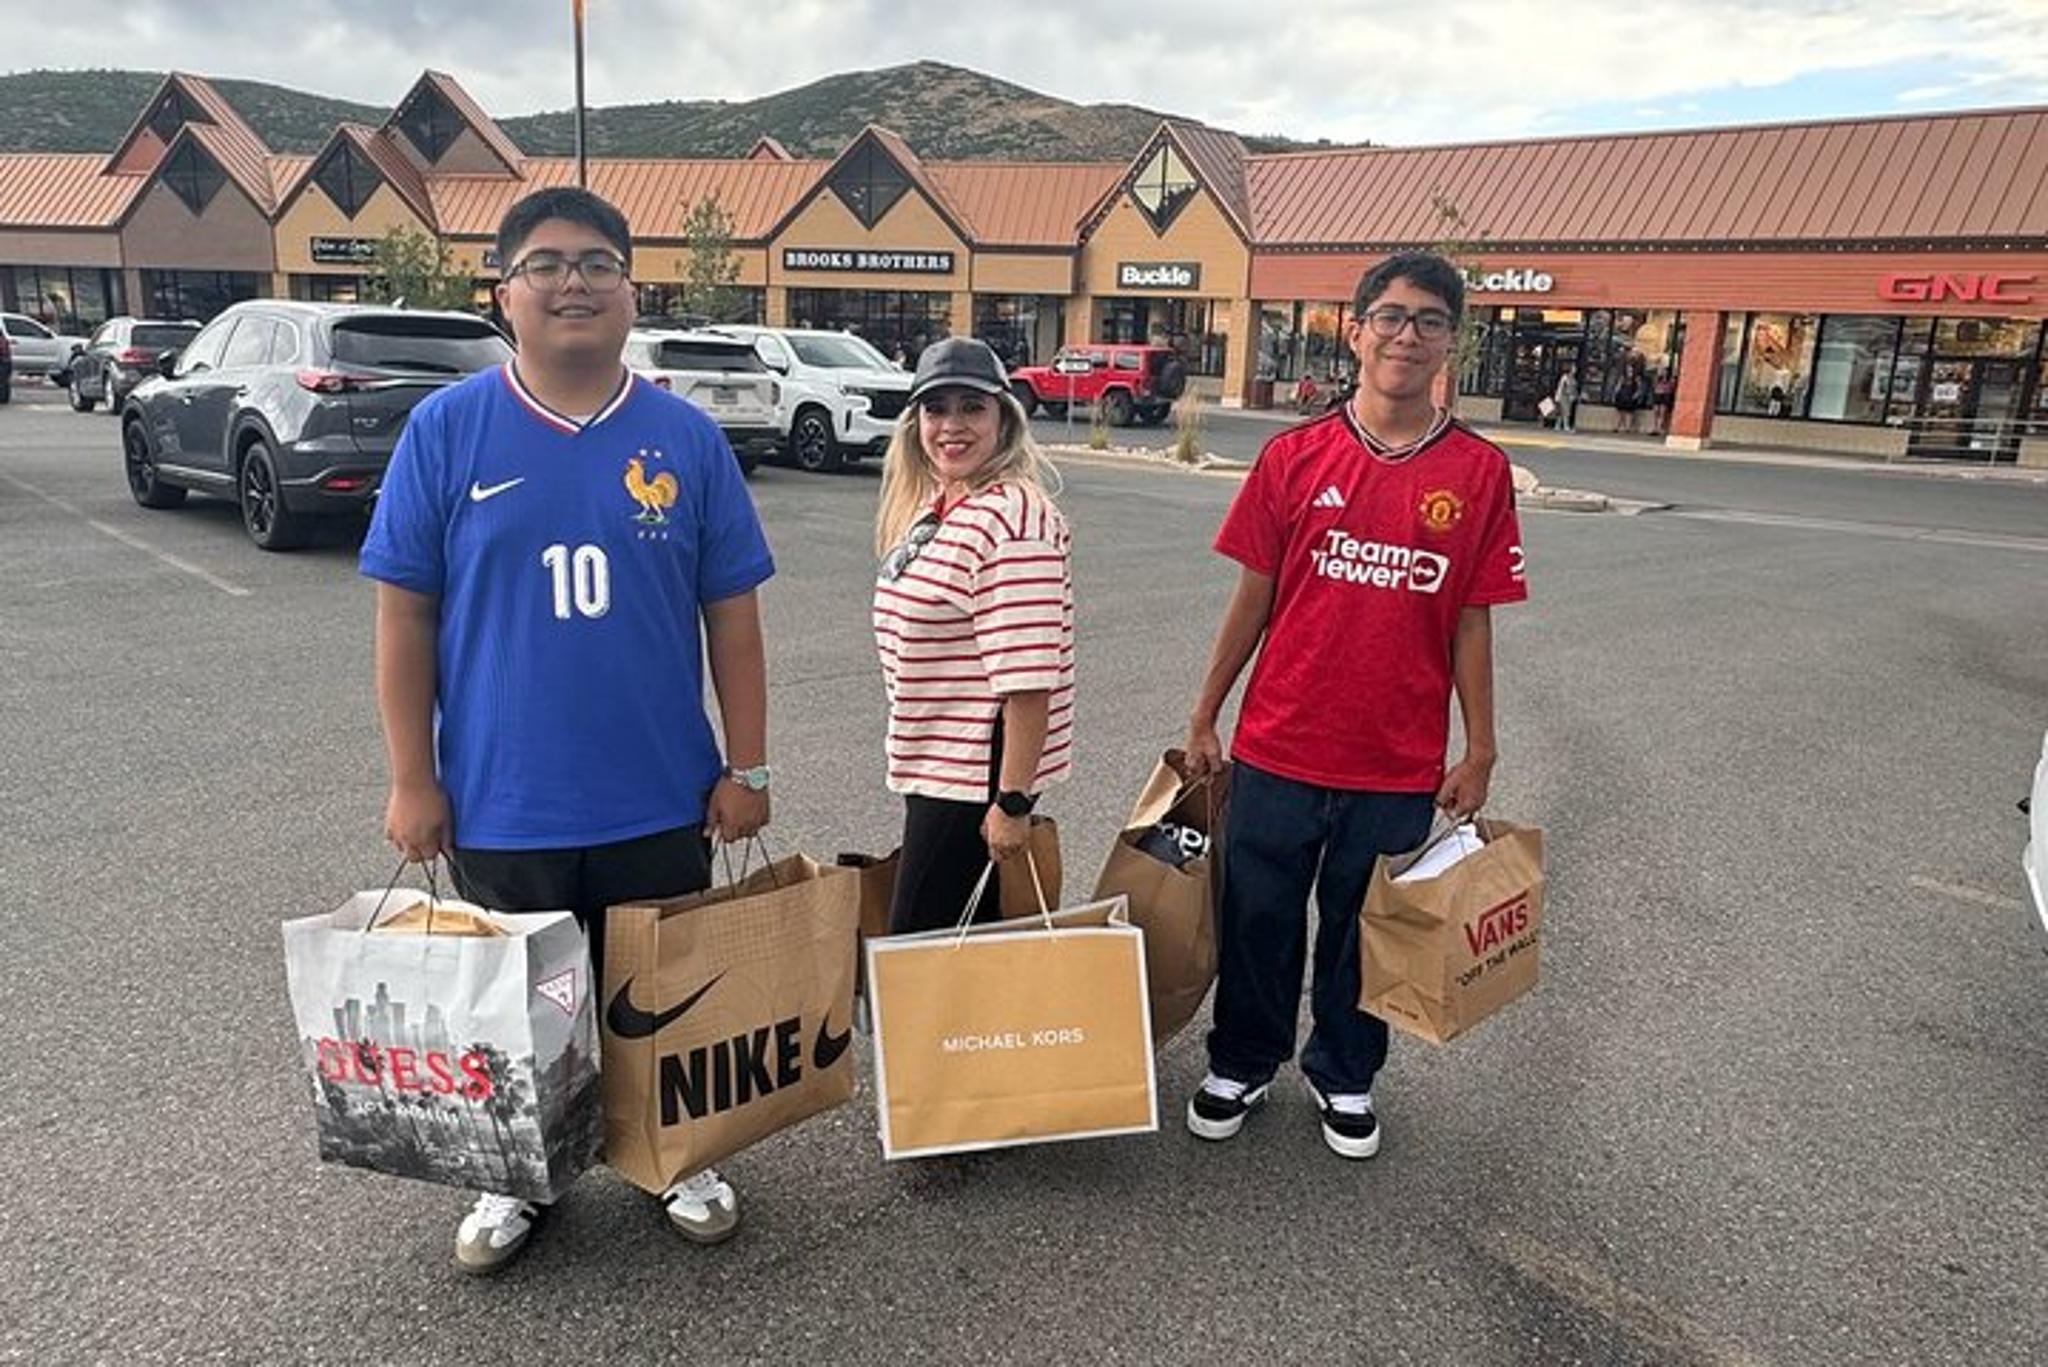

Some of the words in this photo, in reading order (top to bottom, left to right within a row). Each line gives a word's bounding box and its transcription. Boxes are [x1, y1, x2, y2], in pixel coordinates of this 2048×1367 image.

[786, 252, 852, 267] BROOKS
[857, 253, 950, 270] BROTHERS
[1122, 266, 1192, 285] Buckle
[1461, 268, 1553, 292] uckle
[1878, 273, 2037, 301] GNC
[1327, 529, 1411, 567] Team
[542, 543, 610, 619] 10
[1464, 889, 1529, 957] VANS
[943, 1032, 1026, 1052] MICHAEL
[1031, 1027, 1085, 1046] KORS
[317, 1036, 493, 1101] GUESS
[660, 1016, 801, 1127] NIKE
